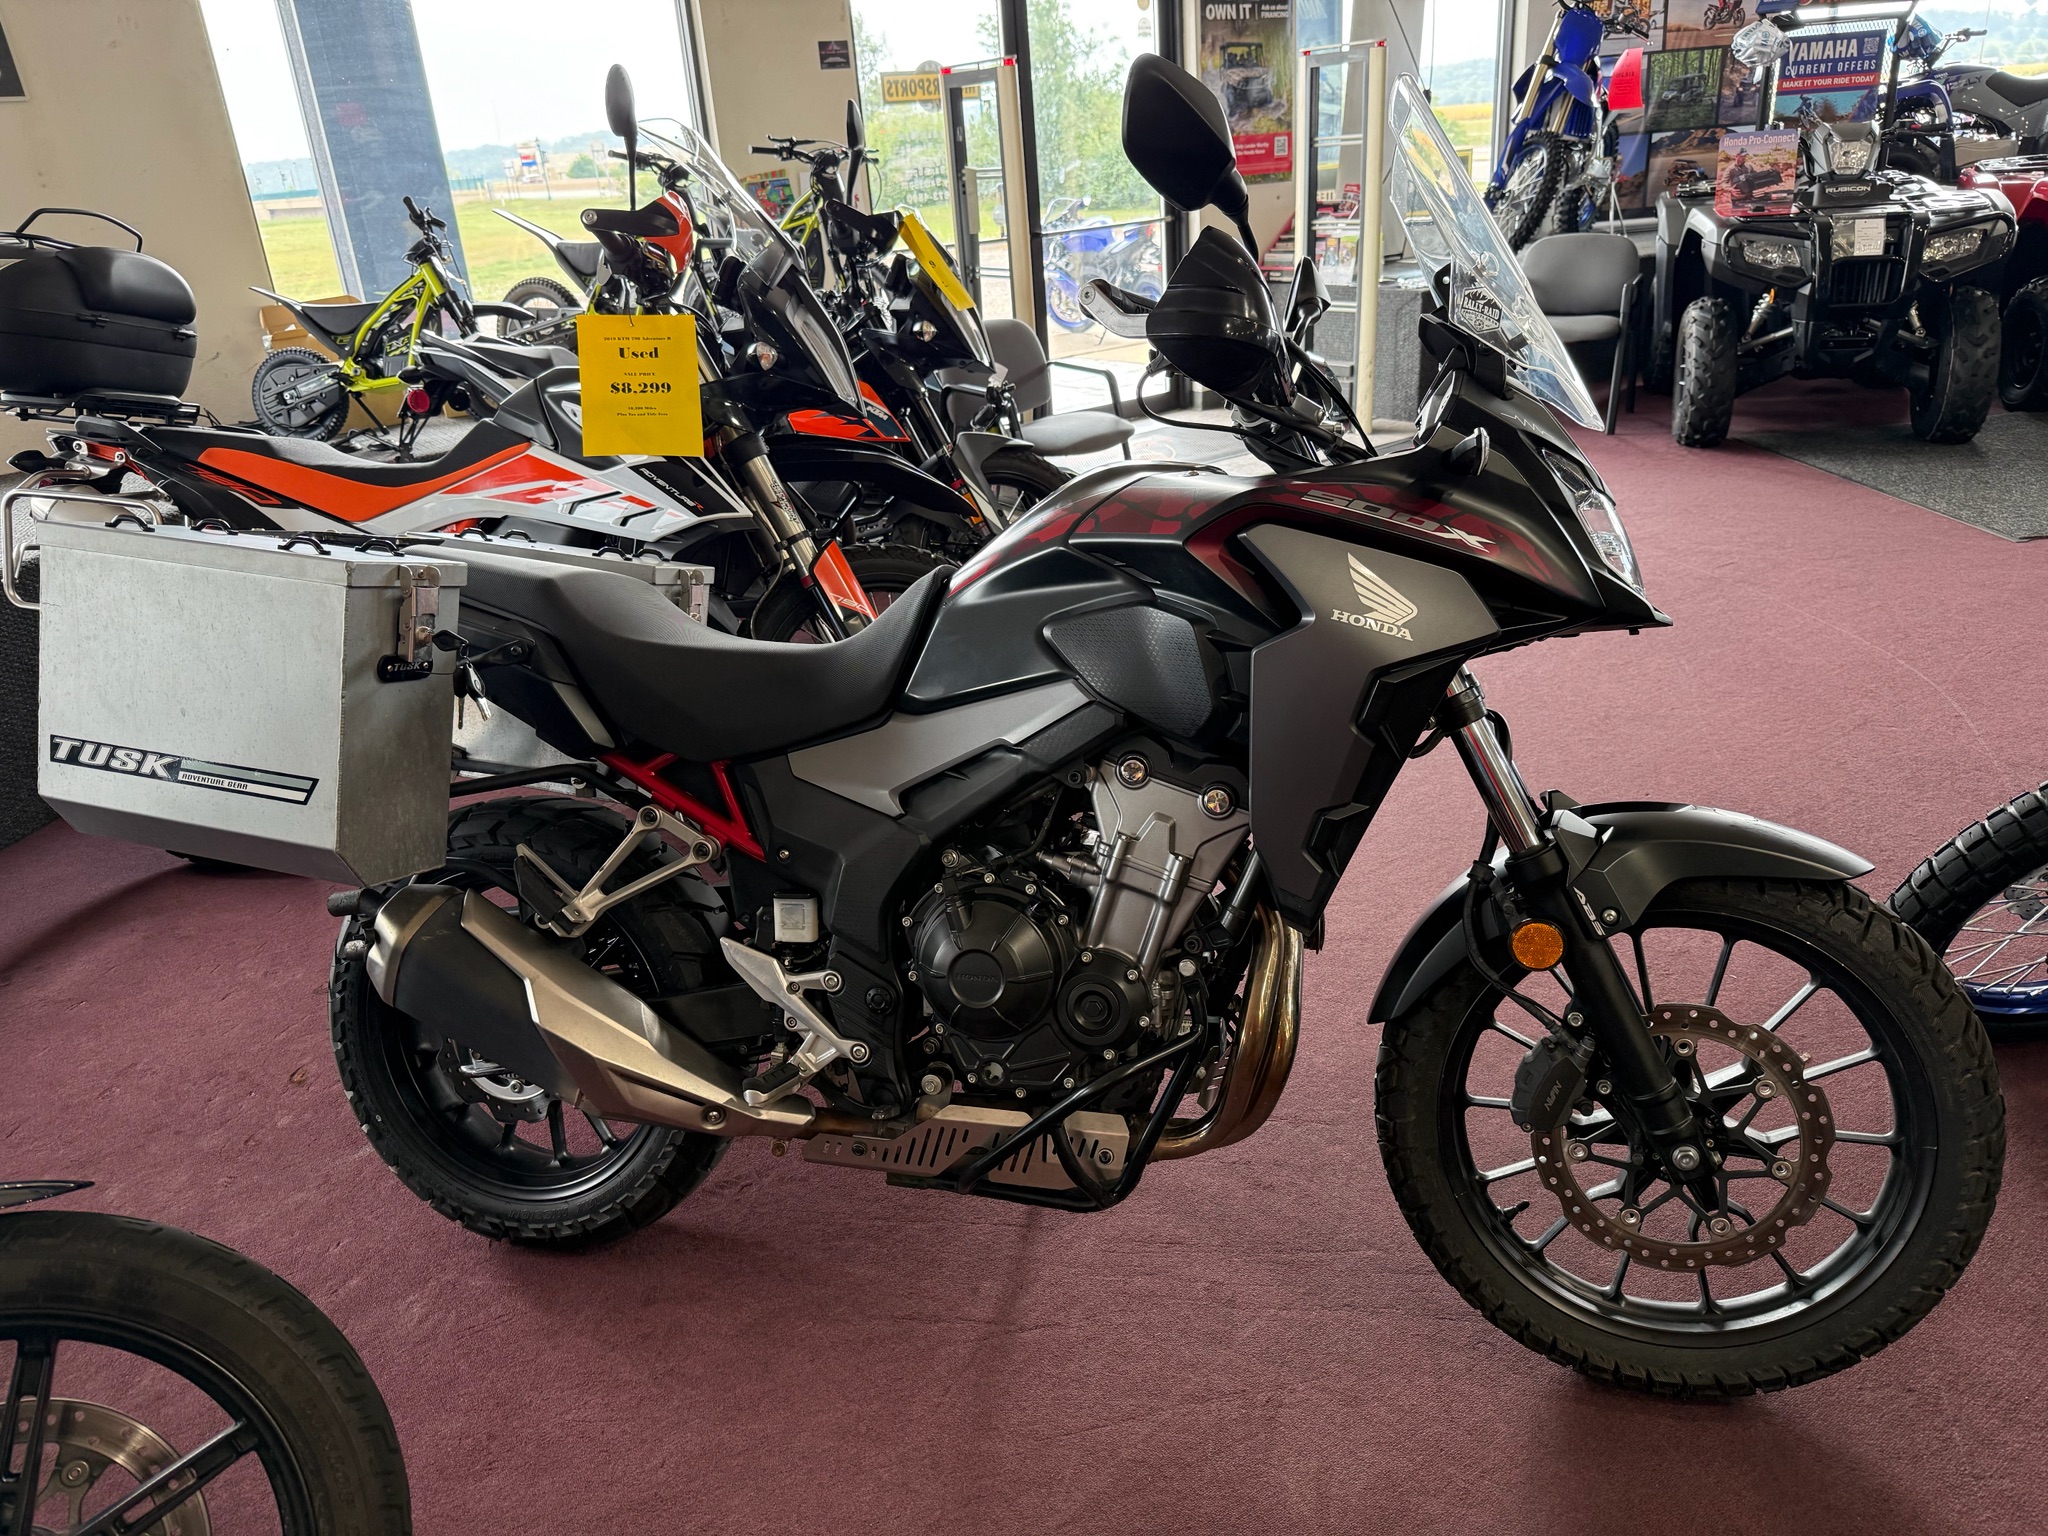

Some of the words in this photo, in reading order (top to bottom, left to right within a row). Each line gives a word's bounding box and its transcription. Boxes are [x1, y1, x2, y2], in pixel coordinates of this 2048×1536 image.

[1206, 3, 1237, 20] OWN
[1239, 3, 1252, 20] IT
[1790, 39, 1858, 61] YAMAHA
[1785, 62, 1833, 76] CURRENT
[1837, 59, 1877, 72] OFFERS
[1782, 80, 1803, 88] MAKE
[1813, 78, 1832, 86] YOUR
[1833, 77, 1850, 85] RIDE
[1851, 75, 1875, 83] TODAY
[1724, 137, 1749, 147] Honda
[1750, 133, 1796, 145] Pro-Connect
[1825, 185, 1871, 194] RUBICON
[1463, 296, 1500, 320] RALLY-RAID
[619, 347, 659, 359] Used
[610, 381, 672, 394] $8,299
[866, 405, 889, 421] KTM
[639, 467, 697, 507] ADVENTURE
[1330, 608, 1414, 642] HONDA
[394, 661, 421, 672] TUSK
[52, 736, 181, 780] TUSK
[181, 773, 226, 787] ADVENTURE
[227, 780, 249, 790] GEAR
[1573, 886, 1606, 936] ABS
[955, 972, 999, 983] HONDA
